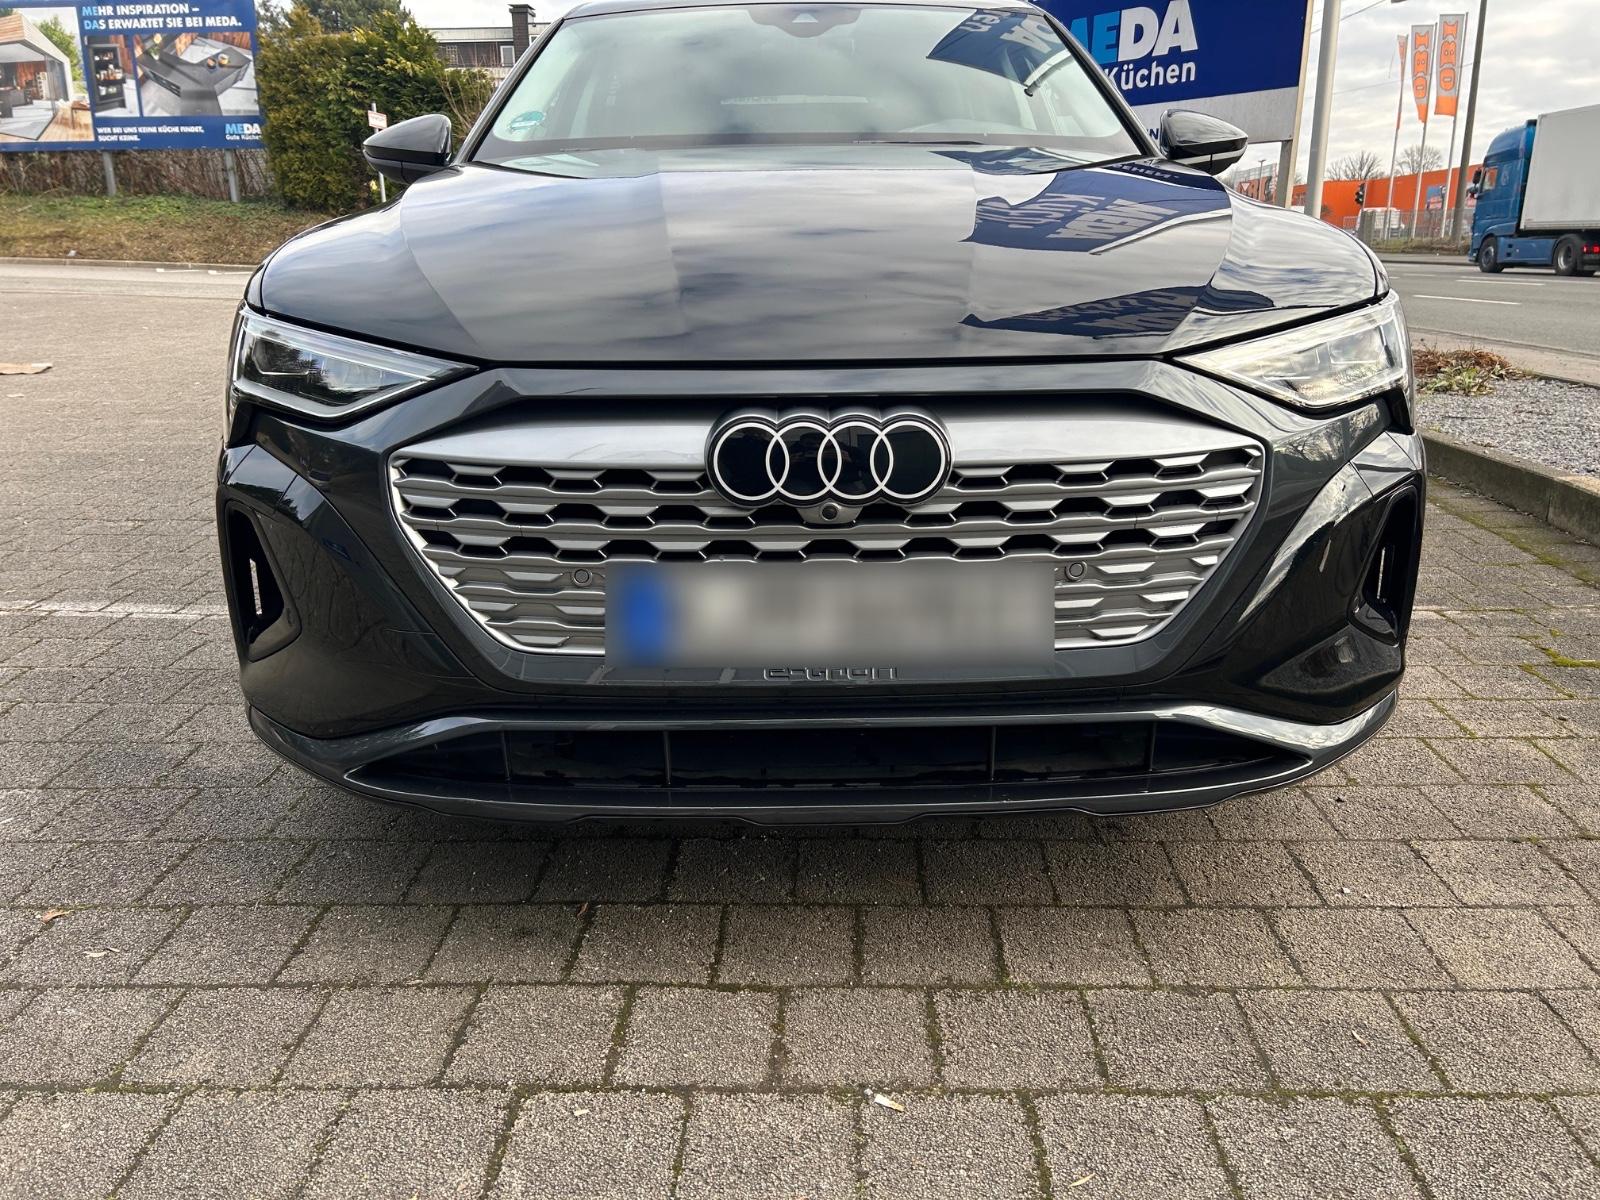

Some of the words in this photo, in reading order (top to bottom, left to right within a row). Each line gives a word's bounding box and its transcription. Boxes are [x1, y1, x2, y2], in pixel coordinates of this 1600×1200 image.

[82, 6, 114, 16] MEHR
[116, 3, 189, 15] INSPIRATION
[83, 19, 106, 30] DAS
[108, 17, 164, 29] ERWARTET
[166, 16, 184, 28] SIE
[185, 16, 203, 27] BEI
[205, 15, 243, 27] MEDA.
[1440, 20, 1458, 92] OBI
[1413, 31, 1430, 100] OBI
[225, 123, 263, 135] MEDA
